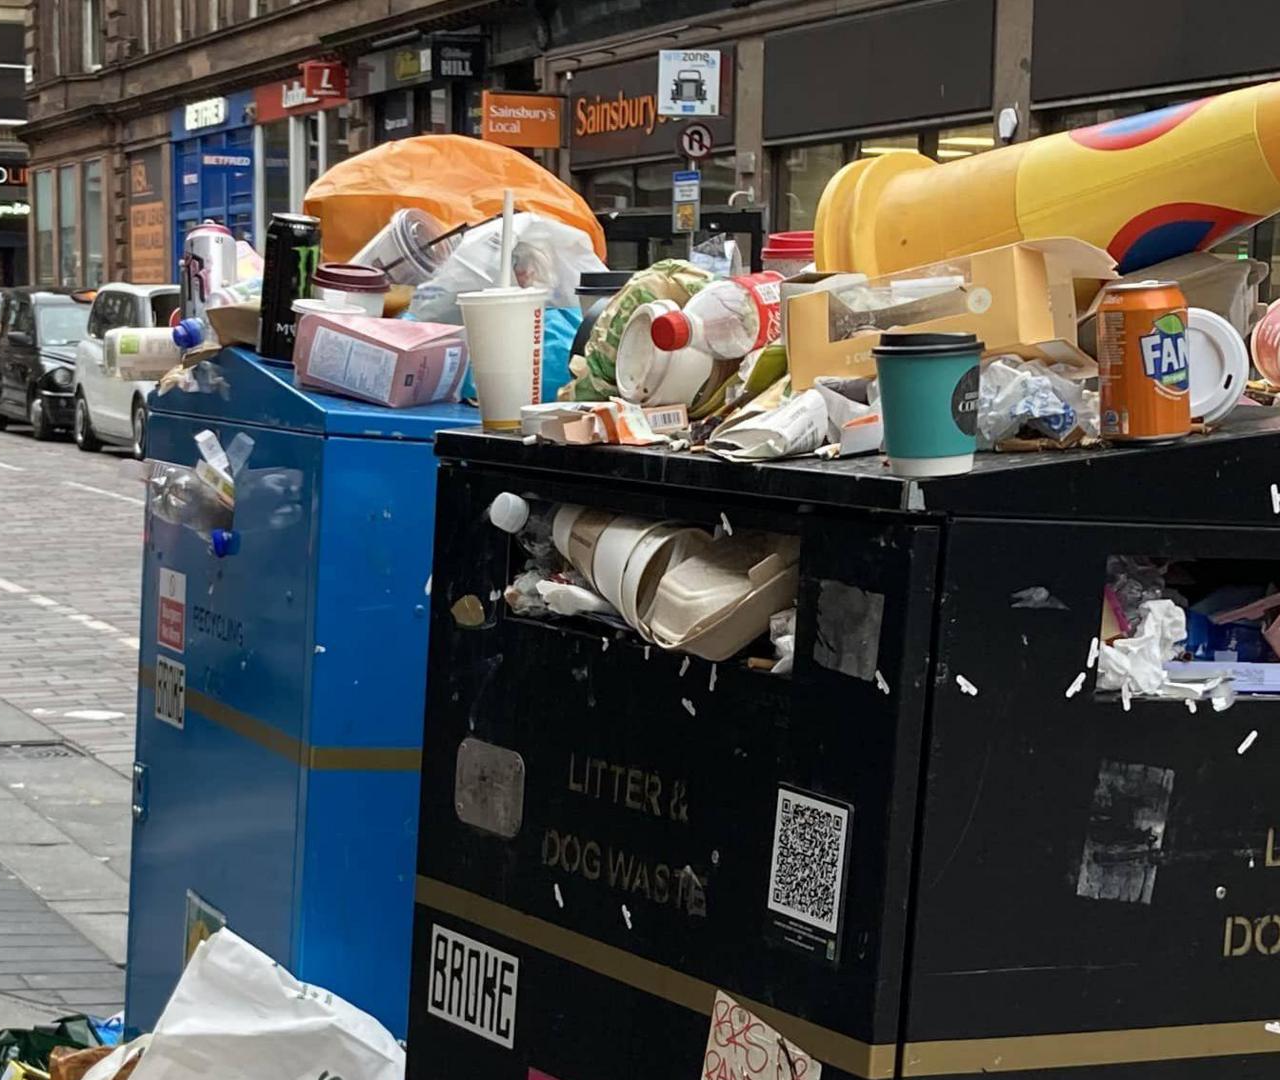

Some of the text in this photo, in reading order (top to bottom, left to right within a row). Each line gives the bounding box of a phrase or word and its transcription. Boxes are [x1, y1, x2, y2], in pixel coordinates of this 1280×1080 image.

[682, 51, 710, 62] zone
[489, 105, 556, 121] Sainsbury's
[489, 120, 521, 133] Local
[576, 90, 666, 136] Sainsbury
[204, 156, 250, 166] BETFRED
[531, 308, 542, 405] BURGER KING
[193, 606, 244, 647] RECYCLING
[569, 752, 690, 823] LITTER &
[543, 829, 708, 912] DOG WASTE
